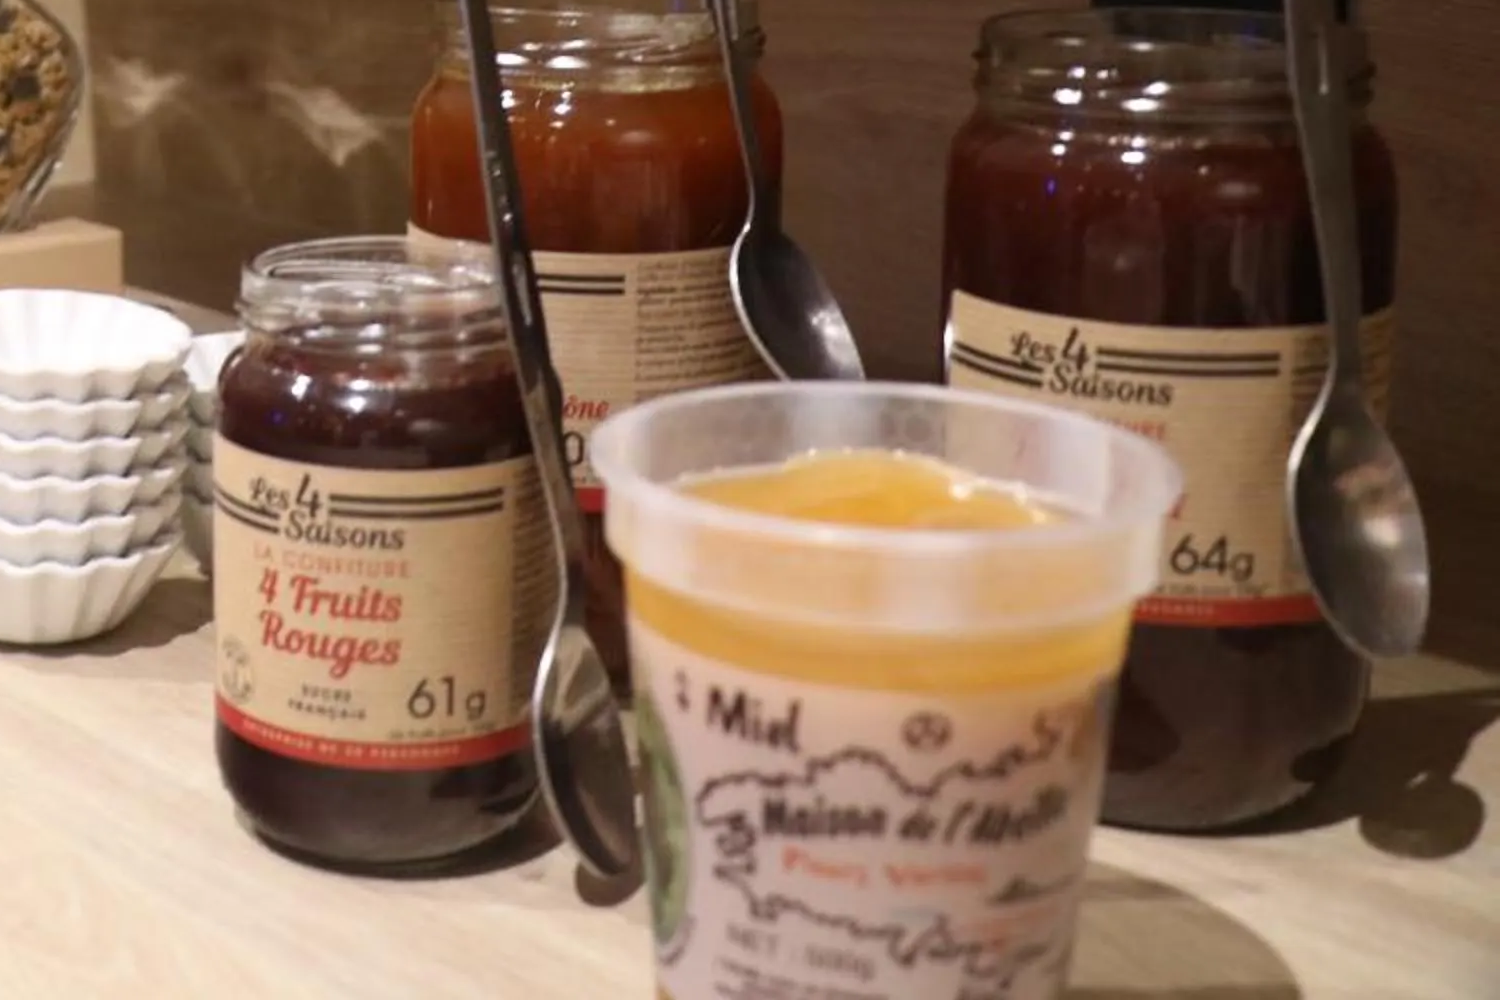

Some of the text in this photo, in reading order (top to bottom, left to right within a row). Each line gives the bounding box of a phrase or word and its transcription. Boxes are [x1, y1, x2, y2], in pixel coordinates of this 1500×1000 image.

[1010, 327, 1089, 371] Les 4
[1049, 365, 1174, 406] Saisons
[561, 395, 609, 421] ône
[248, 472, 322, 518] Les 4
[284, 510, 405, 551] Saisons
[253, 542, 413, 580] LA CONFITURE
[1170, 533, 1255, 582] 64g
[258, 566, 404, 623] 4 Fruits
[259, 609, 402, 679] Rouges
[707, 685, 803, 754] Miel
[763, 797, 888, 837] Maison
